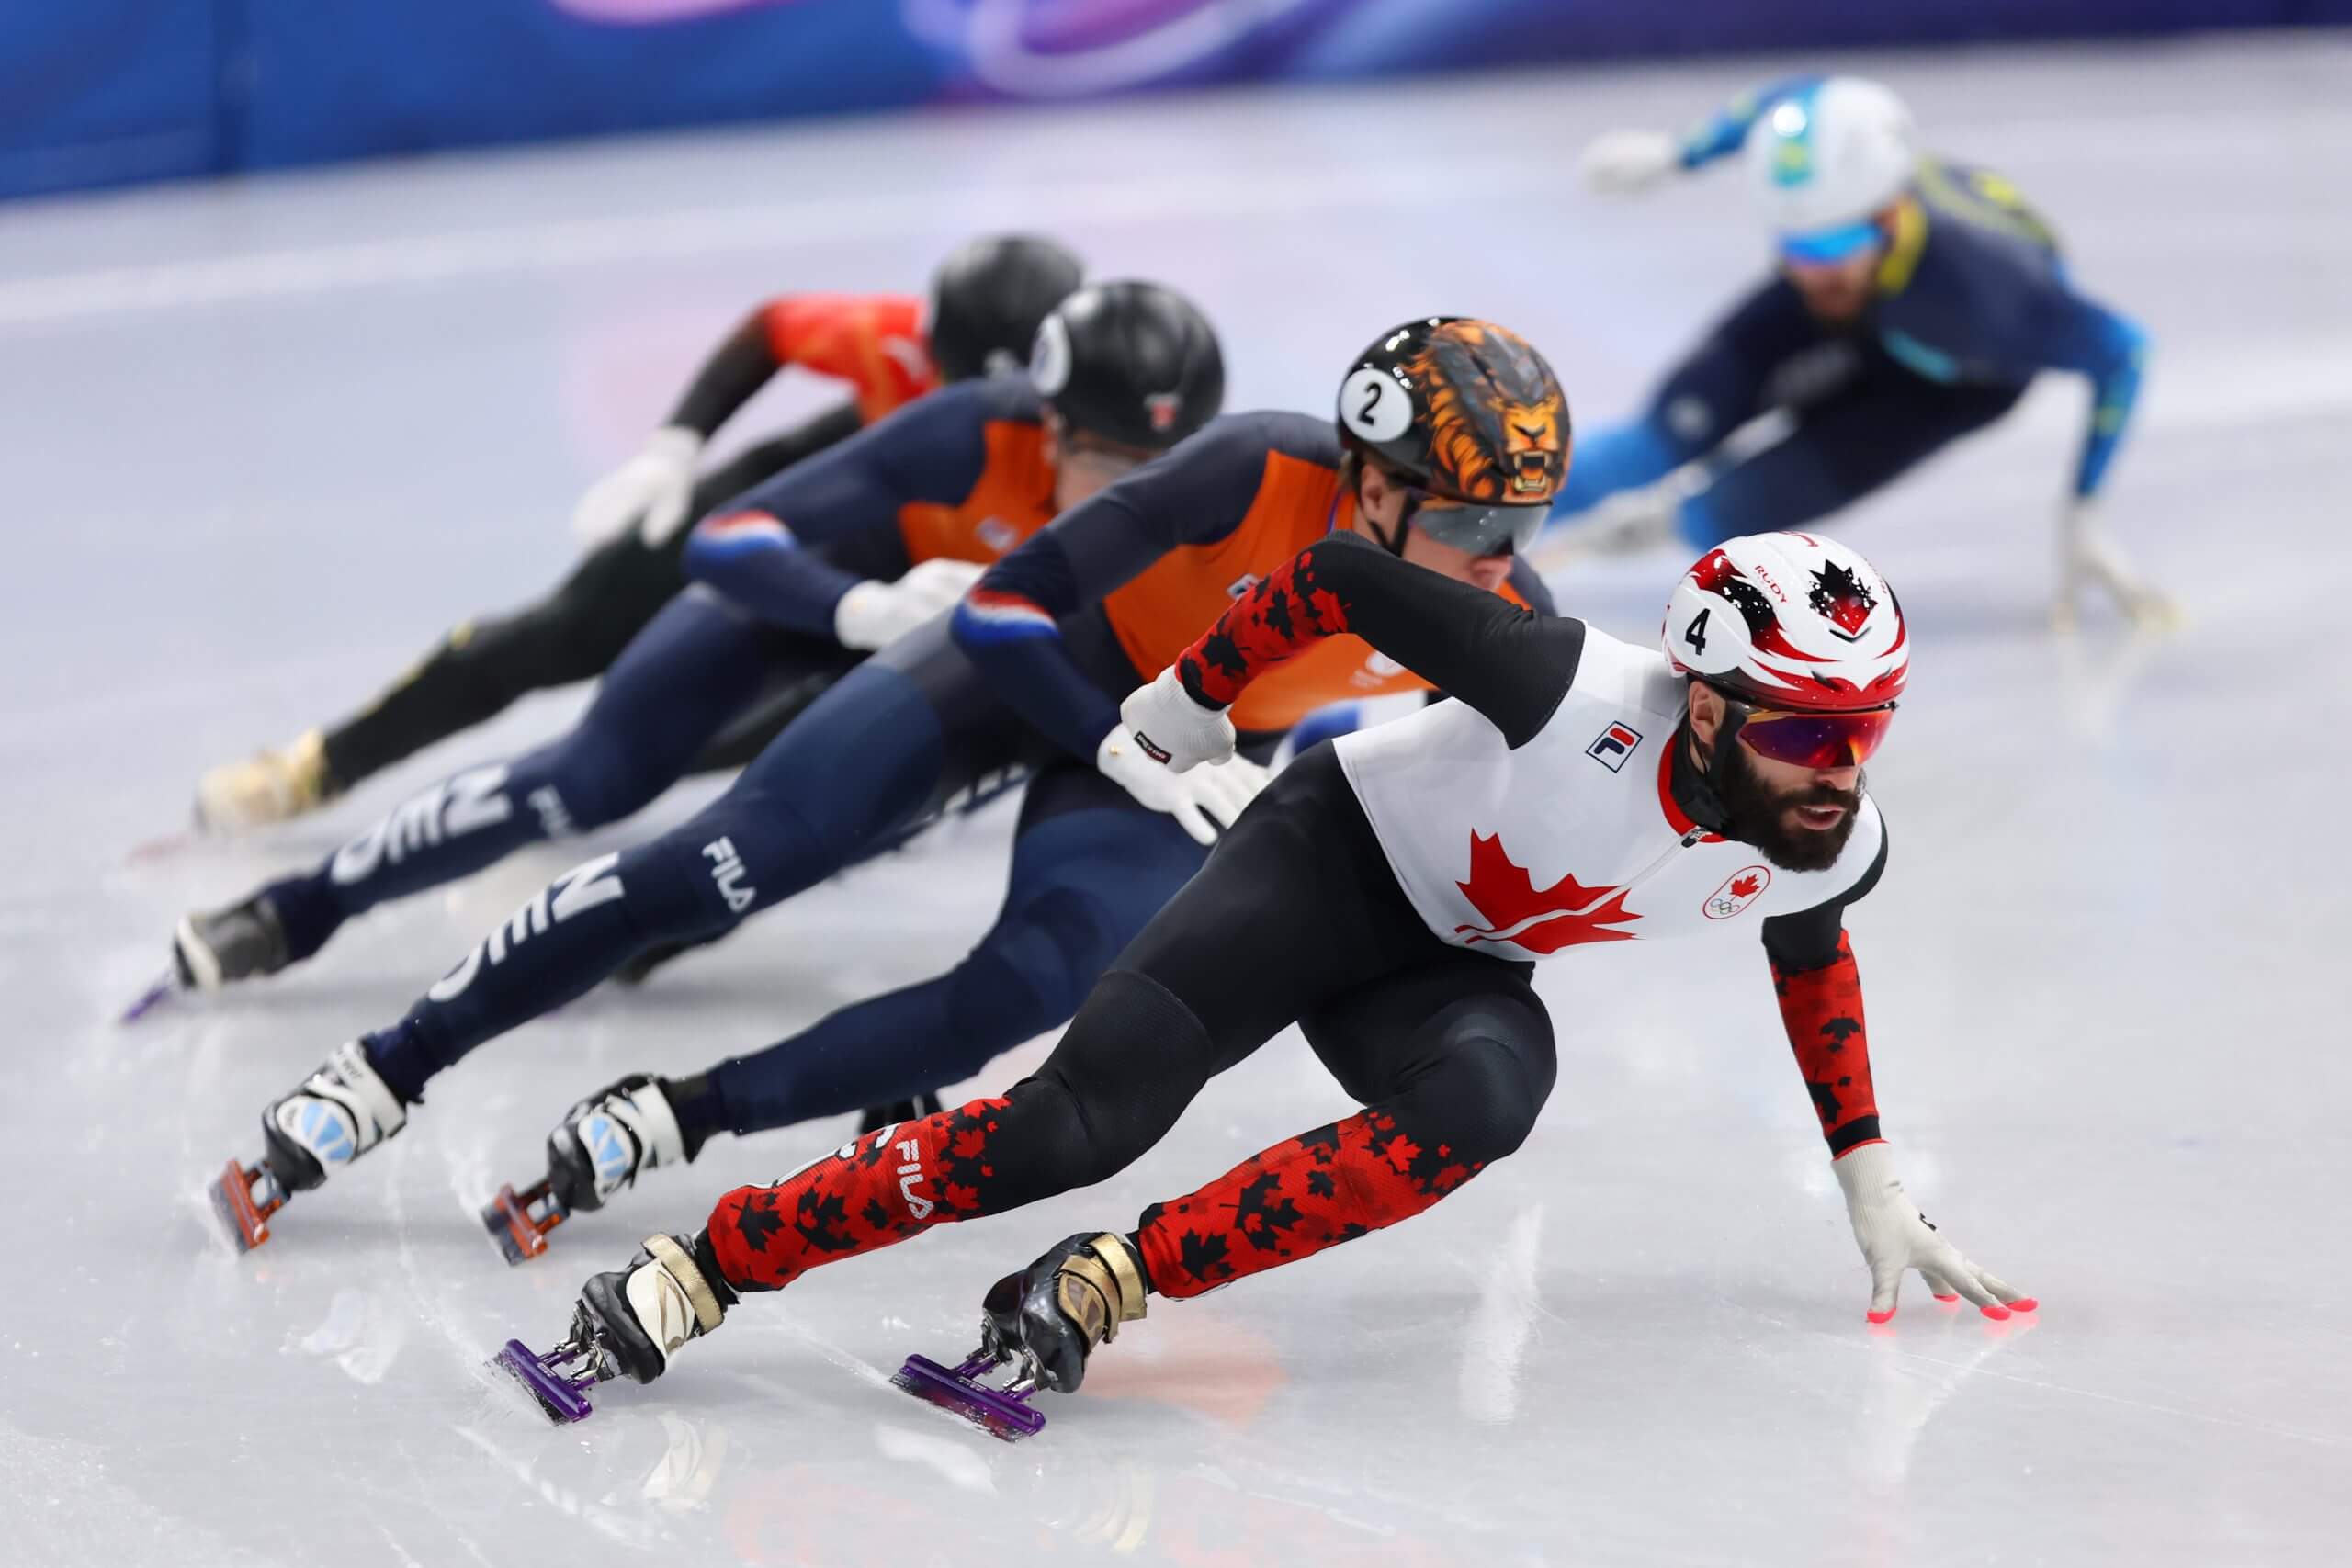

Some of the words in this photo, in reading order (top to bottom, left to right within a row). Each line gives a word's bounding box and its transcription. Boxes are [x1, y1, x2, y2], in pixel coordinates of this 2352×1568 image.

[1358, 382, 1382, 426] 2
[1754, 565, 1788, 604] RUDY
[1685, 608, 1711, 656] 4
[702, 836, 757, 913] FILA
[896, 1138, 934, 1220] FILA
